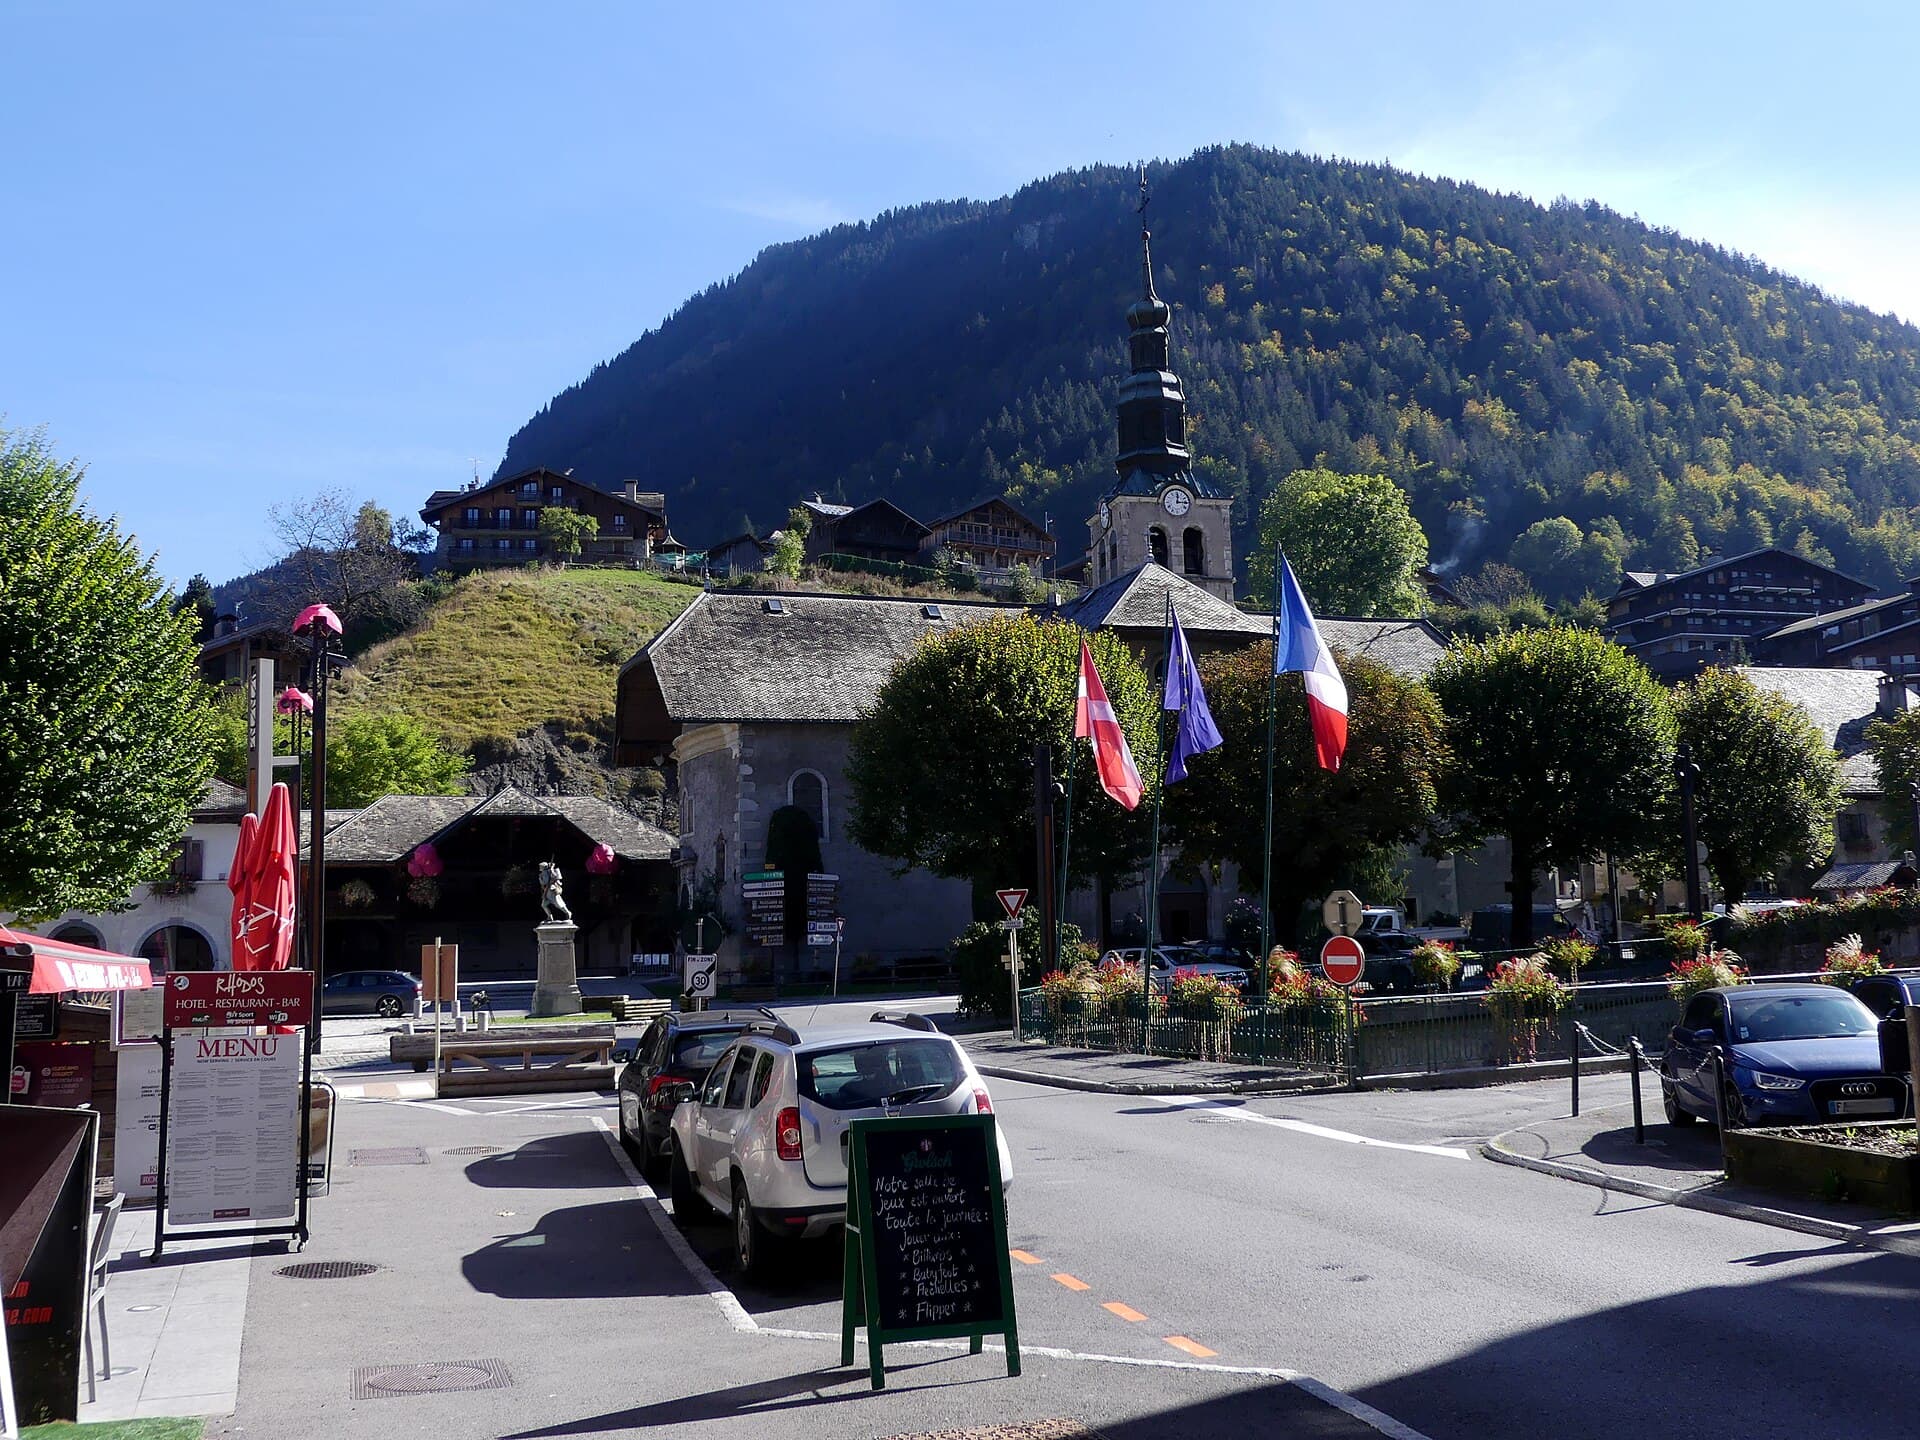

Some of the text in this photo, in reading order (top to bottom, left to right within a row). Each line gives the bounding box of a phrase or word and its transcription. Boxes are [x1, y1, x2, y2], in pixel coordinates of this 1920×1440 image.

[695, 976, 707, 986] 30
[175, 999, 208, 1010] HOTEL
[215, 998, 275, 1009] RESTAURANT
[282, 997, 301, 1008] BAR
[196, 1037, 279, 1058] MENU
[875, 1176, 910, 1193] Notre
[876, 1193, 905, 1216] jeux
[885, 1211, 921, 1230] toute
[916, 1300, 956, 1322] Flipper
